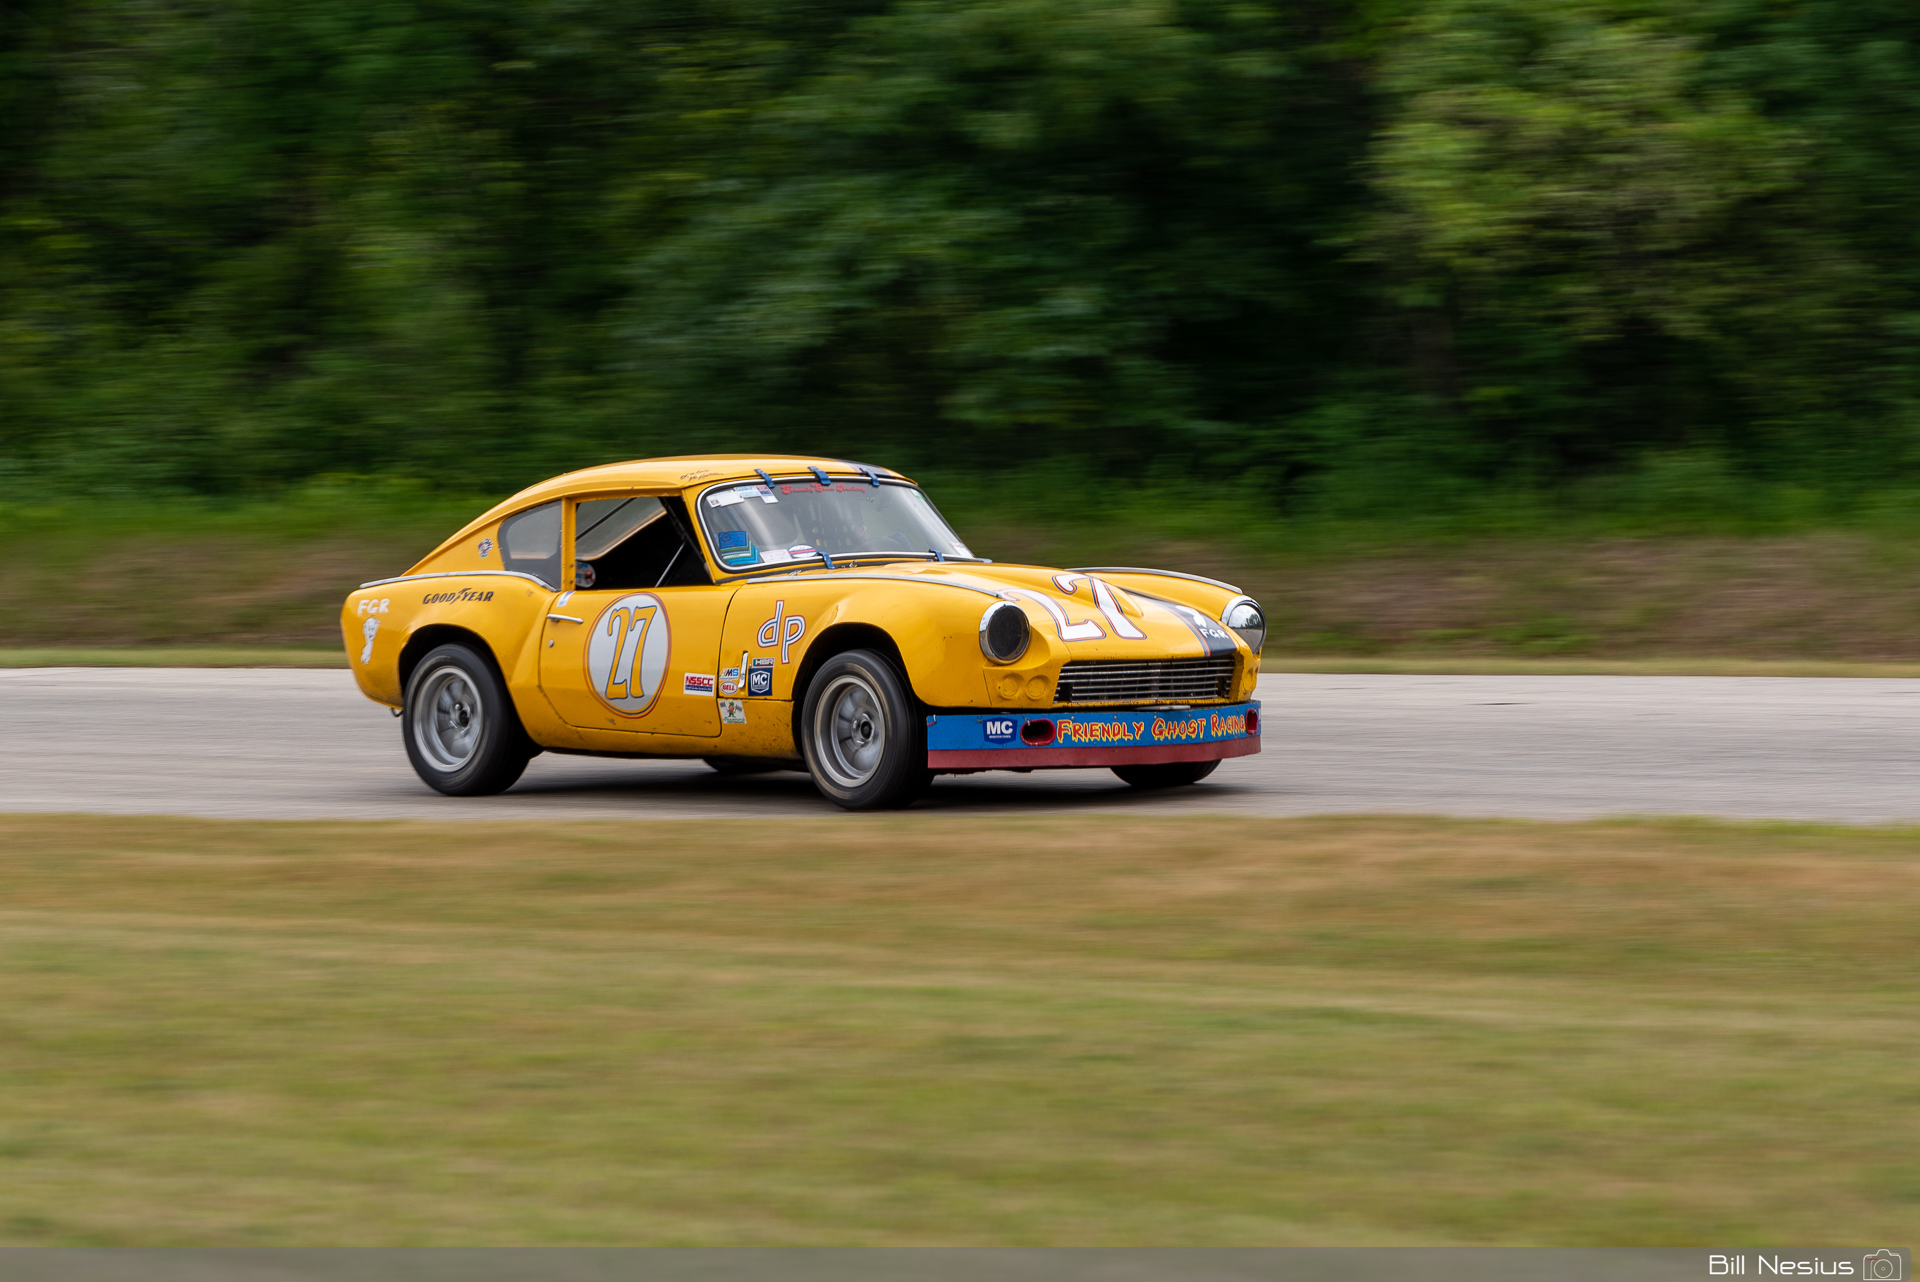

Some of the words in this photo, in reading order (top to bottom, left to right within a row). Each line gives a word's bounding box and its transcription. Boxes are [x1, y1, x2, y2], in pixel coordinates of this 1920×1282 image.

[357, 598, 390, 616] FGR
[998, 573, 1147, 642] 27
[1200, 628, 1229, 640] FGR
[606, 605, 657, 700] 27
[685, 676, 713, 687] NSSCC
[752, 674, 768, 685] MC
[986, 720, 1013, 734] MC
[1057, 719, 1145, 744] FRIENDLY
[1151, 717, 1207, 741] GHOST
[1210, 714, 1246, 737] RACING
